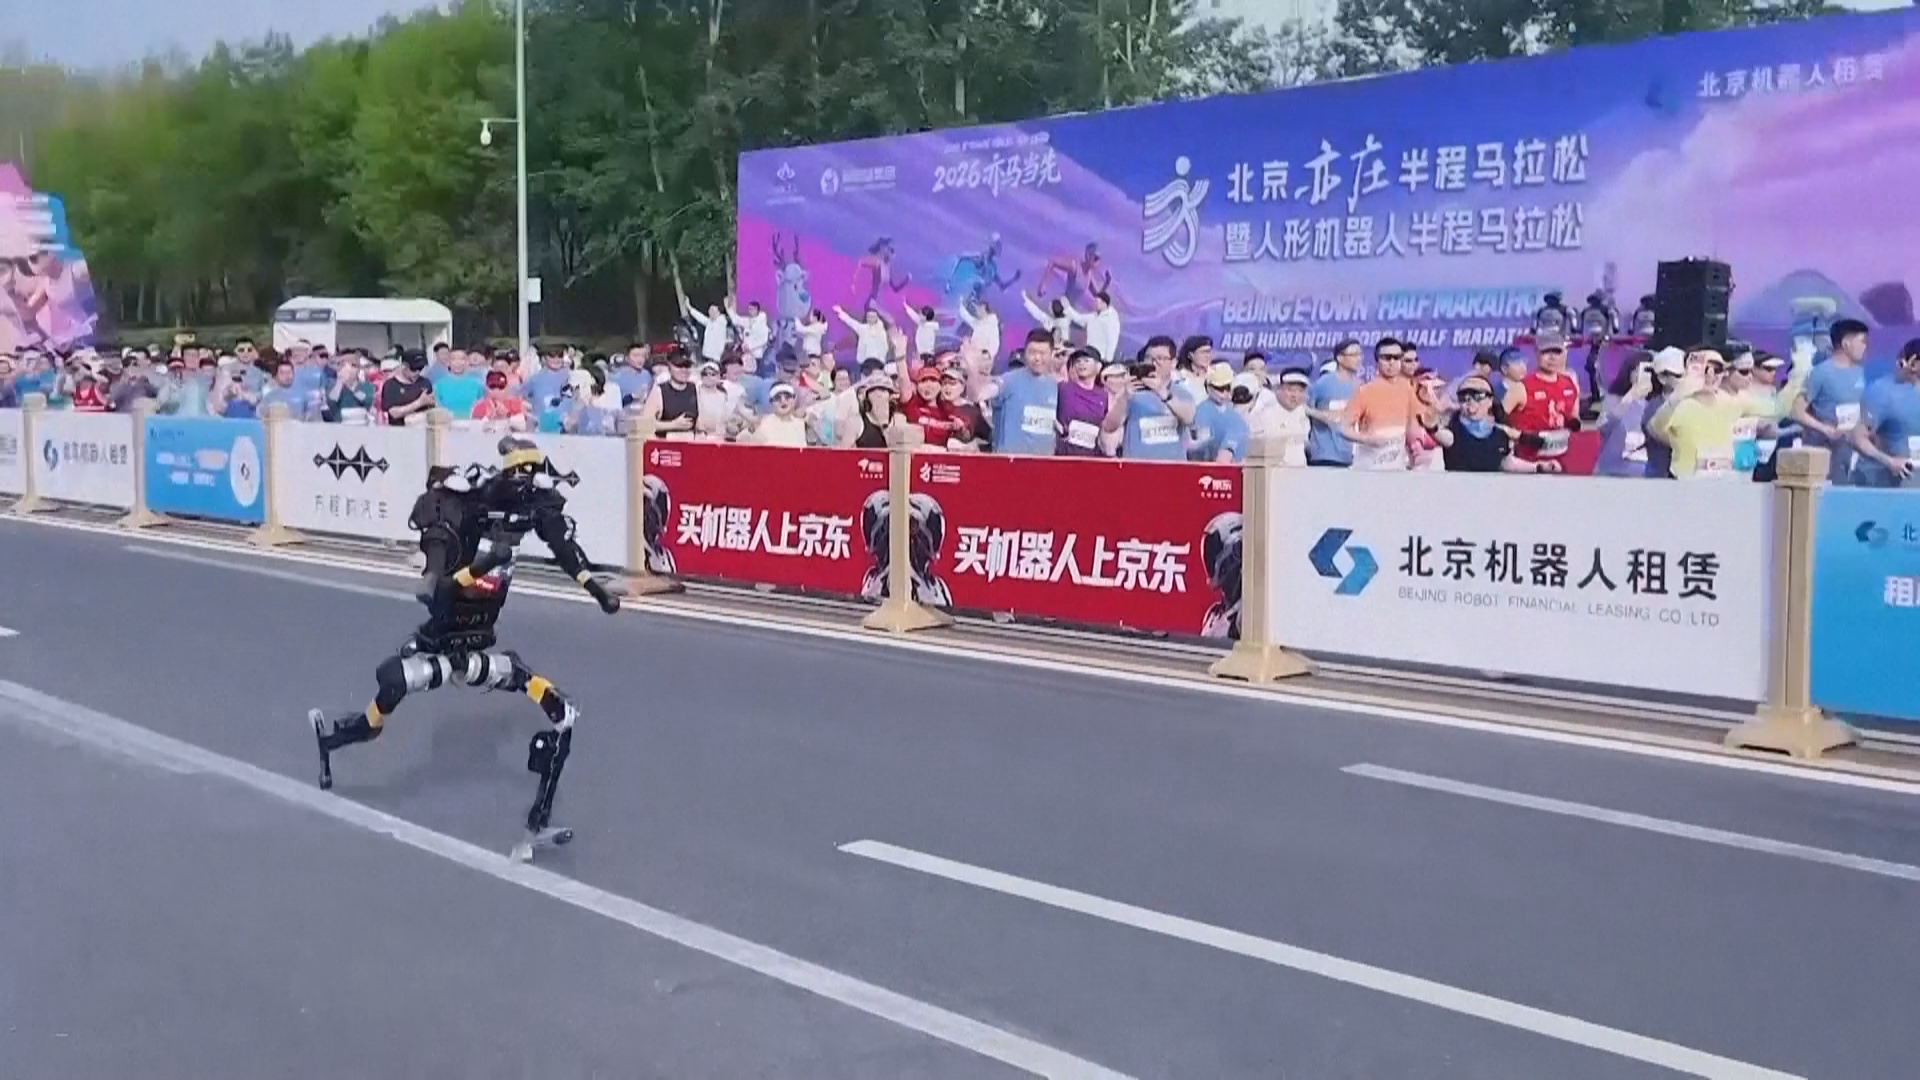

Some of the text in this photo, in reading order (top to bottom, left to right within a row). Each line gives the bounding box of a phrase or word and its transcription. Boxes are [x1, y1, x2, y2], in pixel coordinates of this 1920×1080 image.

[1227, 134, 1589, 214] 北京亦庄半程马拉松
[1224, 202, 1585, 262] 暨人形机器人半程马拉松
[1223, 294, 1294, 323] BEIJING
[1377, 292, 1432, 321] HALF
[1432, 289, 1540, 319] MARATHO
[1221, 332, 1254, 349] AND
[1406, 328, 1449, 347] HALF
[676, 503, 853, 560] 买机器人上京东
[953, 525, 1190, 593] 买机器人上京东
[1398, 535, 1721, 601] 北京机器人租赁
[1884, 575, 1920, 608] 租
[1397, 585, 1447, 603] BEIJING
[1454, 591, 1500, 607] ROBOT
[1508, 595, 1576, 613] FINANCIAL
[1587, 604, 1650, 622] LEASING
